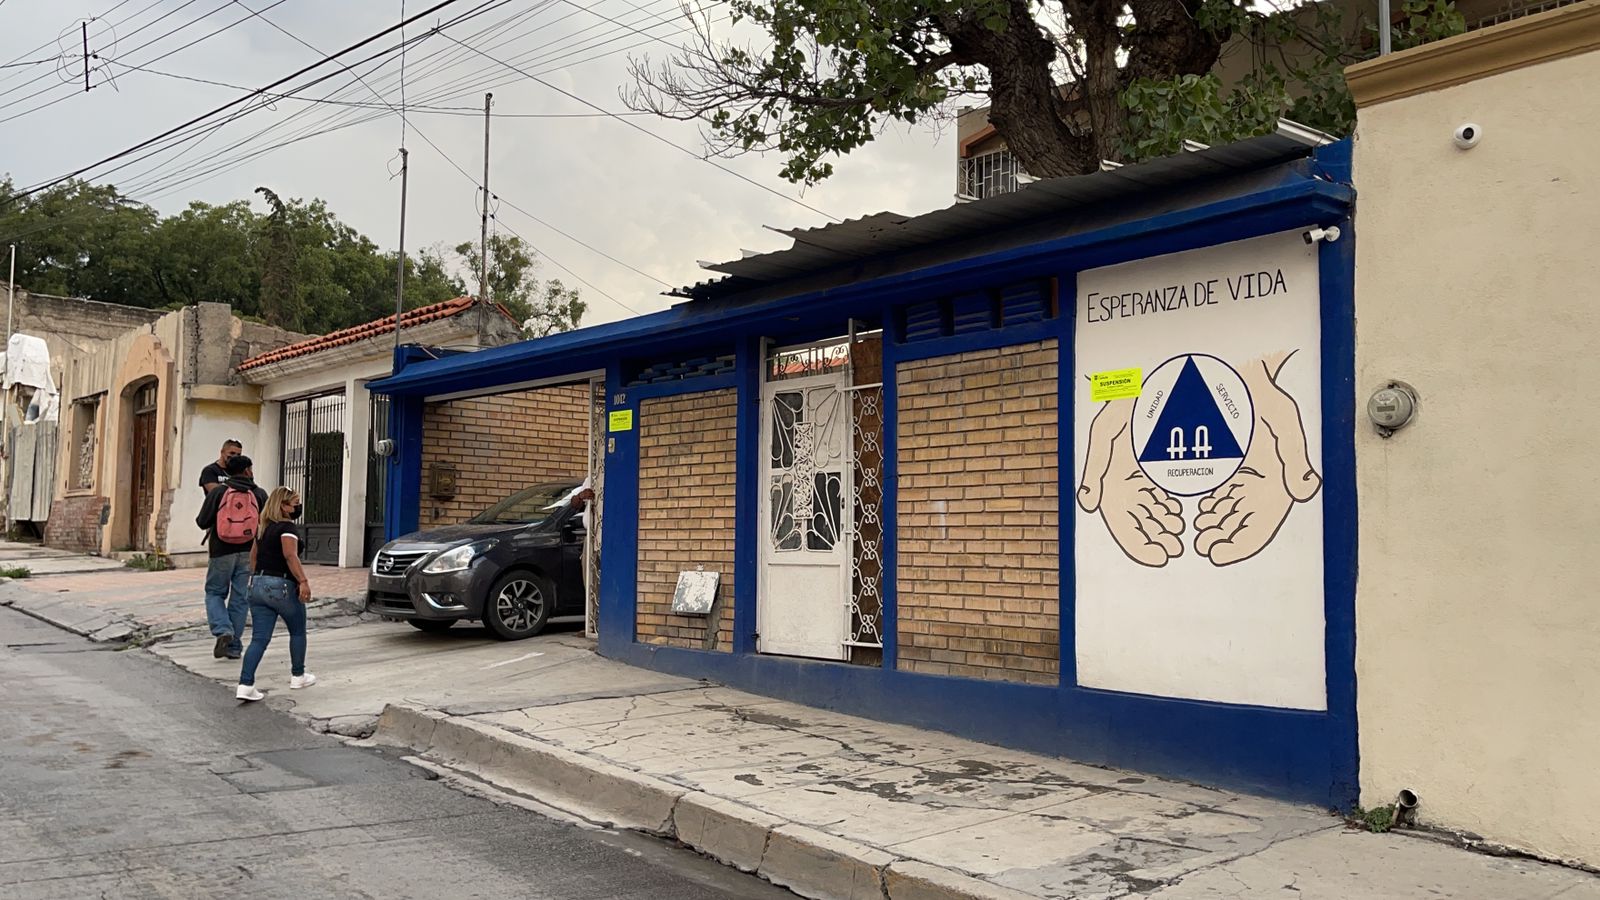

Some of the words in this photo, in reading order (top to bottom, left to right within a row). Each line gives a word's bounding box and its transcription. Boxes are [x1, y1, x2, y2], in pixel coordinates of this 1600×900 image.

[1087, 285, 1189, 323] ESPERANZA
[1194, 279, 1219, 307] DE
[1227, 268, 1287, 301] VIDA
[1146, 390, 1164, 419] UNIDAD
[1216, 383, 1240, 419] SERVICIO
[1167, 467, 1214, 478] RECUPERACION
